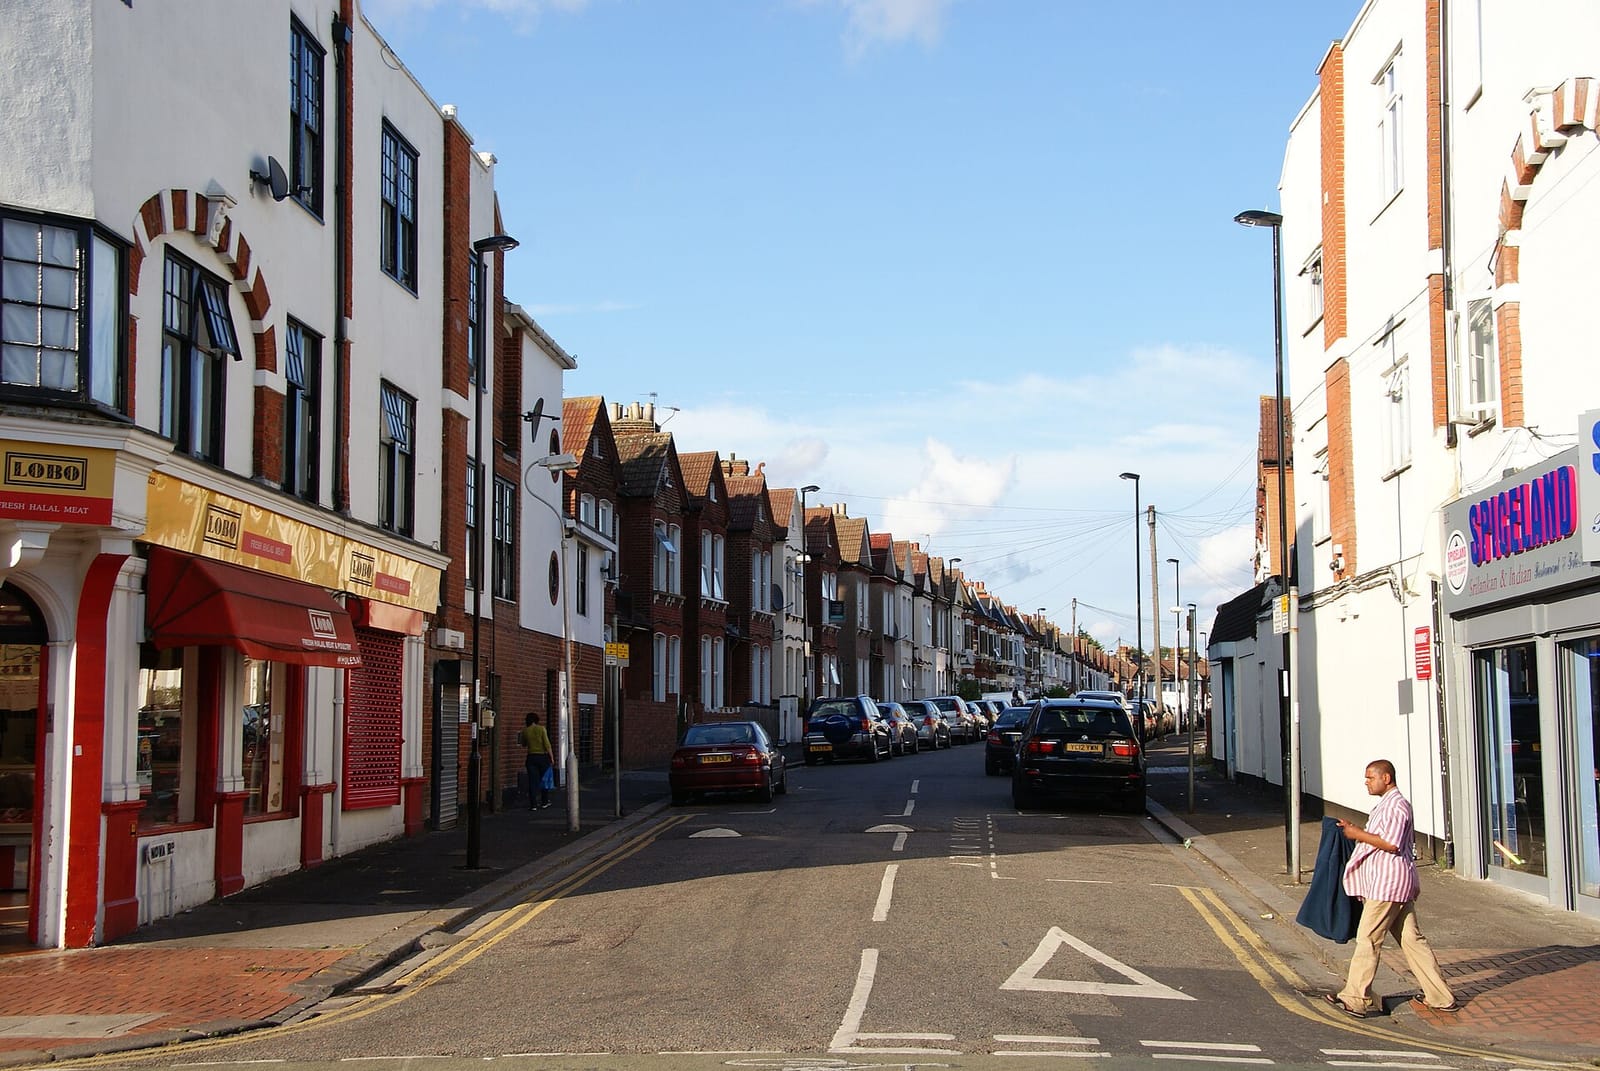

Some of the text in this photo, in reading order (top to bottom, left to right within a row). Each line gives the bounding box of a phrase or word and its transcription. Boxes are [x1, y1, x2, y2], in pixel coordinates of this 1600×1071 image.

[13, 461, 80, 481] LOBO
[29, 503, 61, 513] HALAL
[63, 506, 89, 515] MEAT
[1469, 464, 1577, 568] SPICELAND
[208, 515, 237, 540] LOBO
[352, 559, 372, 579] LOBO
[1509, 563, 1532, 586] Indian
[312, 616, 333, 633] LOBO
[151, 845, 165, 859] NOVA
